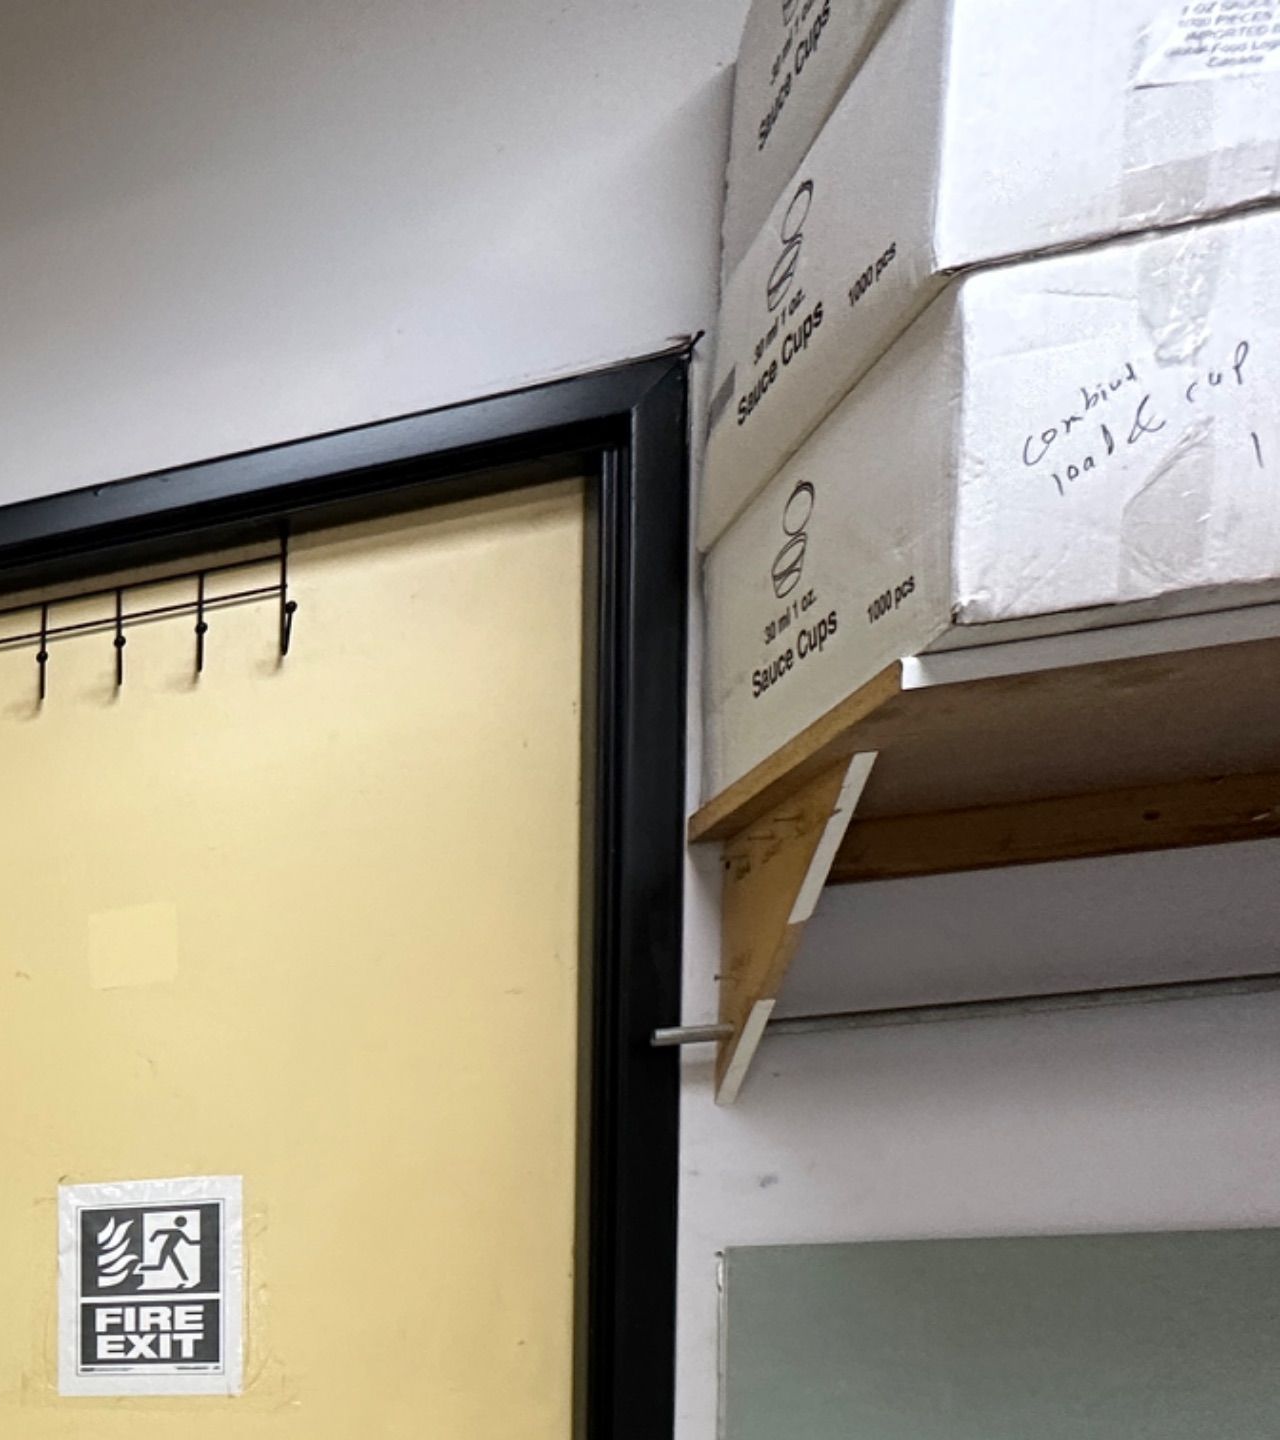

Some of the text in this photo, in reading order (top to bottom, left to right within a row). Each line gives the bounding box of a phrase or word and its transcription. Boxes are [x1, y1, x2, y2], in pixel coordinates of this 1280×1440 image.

[758, 0, 830, 152] Sauce Cups
[874, 241, 897, 283] pcs
[737, 300, 825, 427] Sauce Cups
[867, 575, 917, 625] 1000 pcs
[752, 610, 838, 699] Sauce Cups
[95, 1304, 204, 1333] FIRE
[96, 1332, 204, 1360] EXIT
